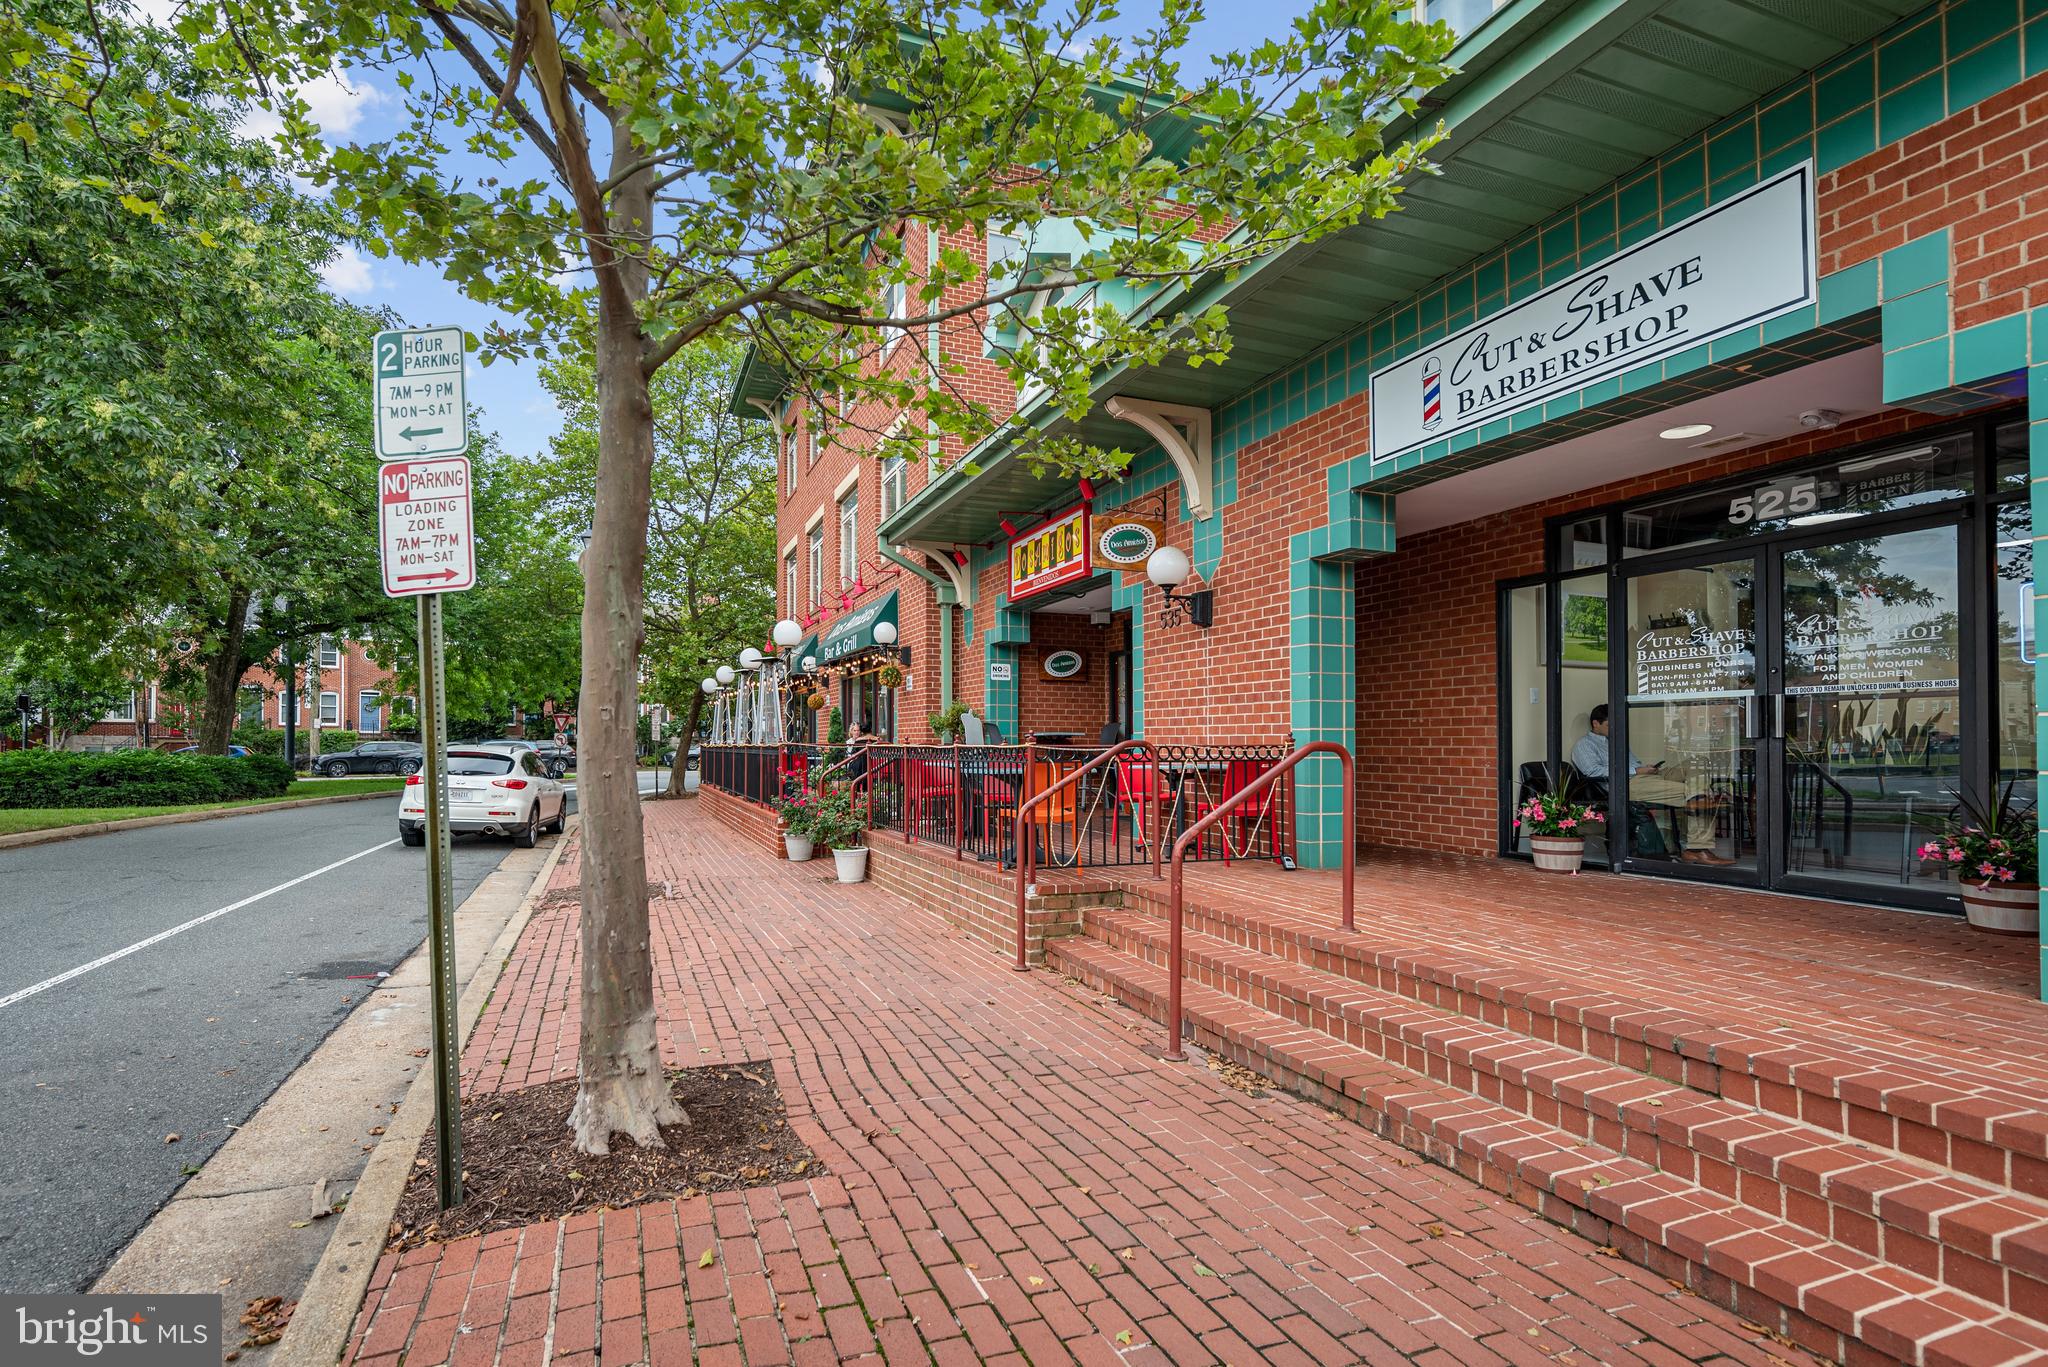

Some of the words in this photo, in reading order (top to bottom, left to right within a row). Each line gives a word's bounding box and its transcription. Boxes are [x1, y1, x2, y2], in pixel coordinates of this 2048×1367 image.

[1527, 332, 1547, 353] &
[1552, 256, 1703, 342] SHAVE
[404, 338, 442, 354] HOUR
[380, 343, 398, 371] 2
[404, 352, 460, 369] PARKING
[1456, 303, 1689, 415] BARBERSHOP
[390, 403, 453, 419] MON-SAT
[384, 472, 408, 495] NO
[411, 470, 463, 490] PARKING
[1860, 473, 1911, 489] BARBER
[1860, 484, 1911, 502] OPEN
[395, 500, 457, 517] LOADING
[1728, 482, 1817, 525] 525
[408, 518, 444, 532] ZONE
[401, 551, 454, 566] MON-SAT
[1160, 607, 1181, 629] 535
[1848, 619, 1858, 629] &
[1674, 637, 1685, 646] &
[1797, 625, 1943, 647] BARBERSHOP
[824, 647, 835, 660] Bar
[835, 642, 842, 656] &
[843, 634, 857, 653] Grill
[1637, 643, 1745, 661] BARBERSHOP
[1865, 646, 1931, 657] WELCOME
[1651, 662, 1701, 672] BUSINESS
[1707, 659, 1745, 669] HOURS
[1813, 664, 1836, 672] FOR
[1873, 659, 1923, 668] WOMEN
[1651, 673, 1690, 681] MON-FRI:
[1851, 669, 1912, 679] CHILDREN
[1846, 683, 1877, 691] UNLOCKED
